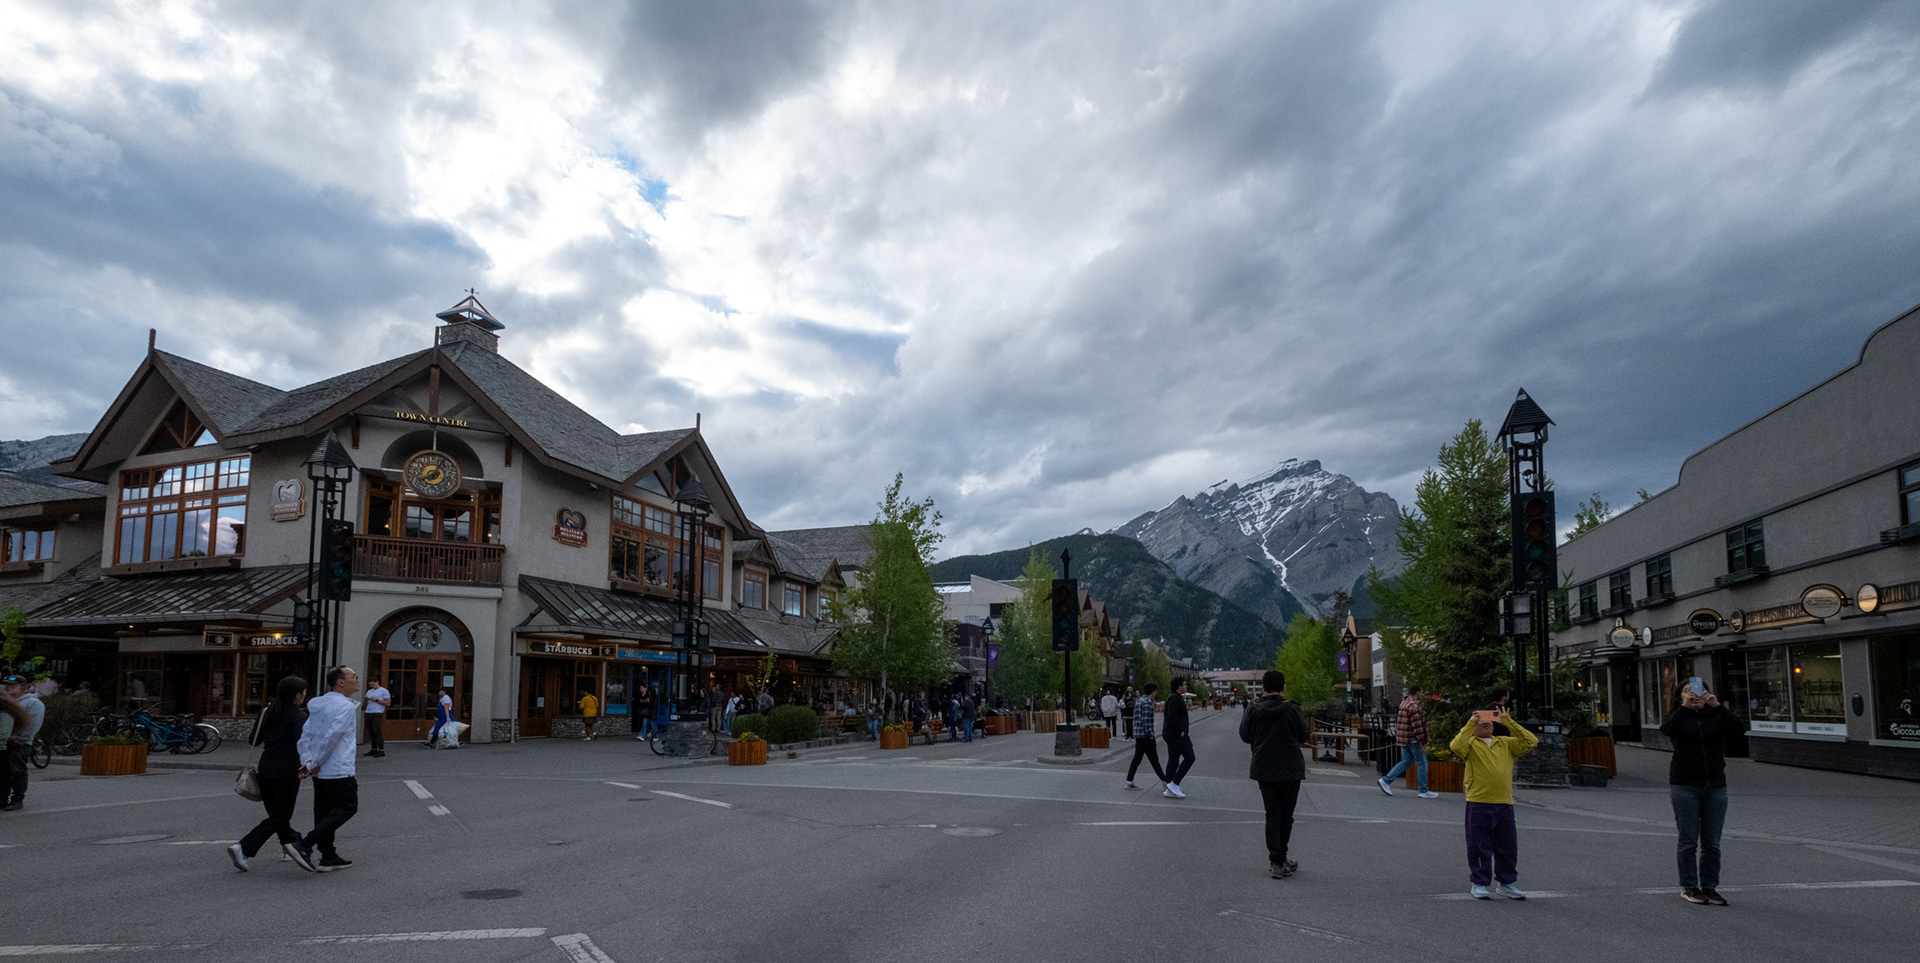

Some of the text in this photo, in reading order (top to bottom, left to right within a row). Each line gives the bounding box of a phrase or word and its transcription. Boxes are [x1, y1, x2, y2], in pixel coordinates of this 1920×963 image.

[395, 411, 469, 427] TOWN CENTRE
[252, 637, 297, 646] STARBUCKS
[545, 645, 592, 655] STARBUCKS
